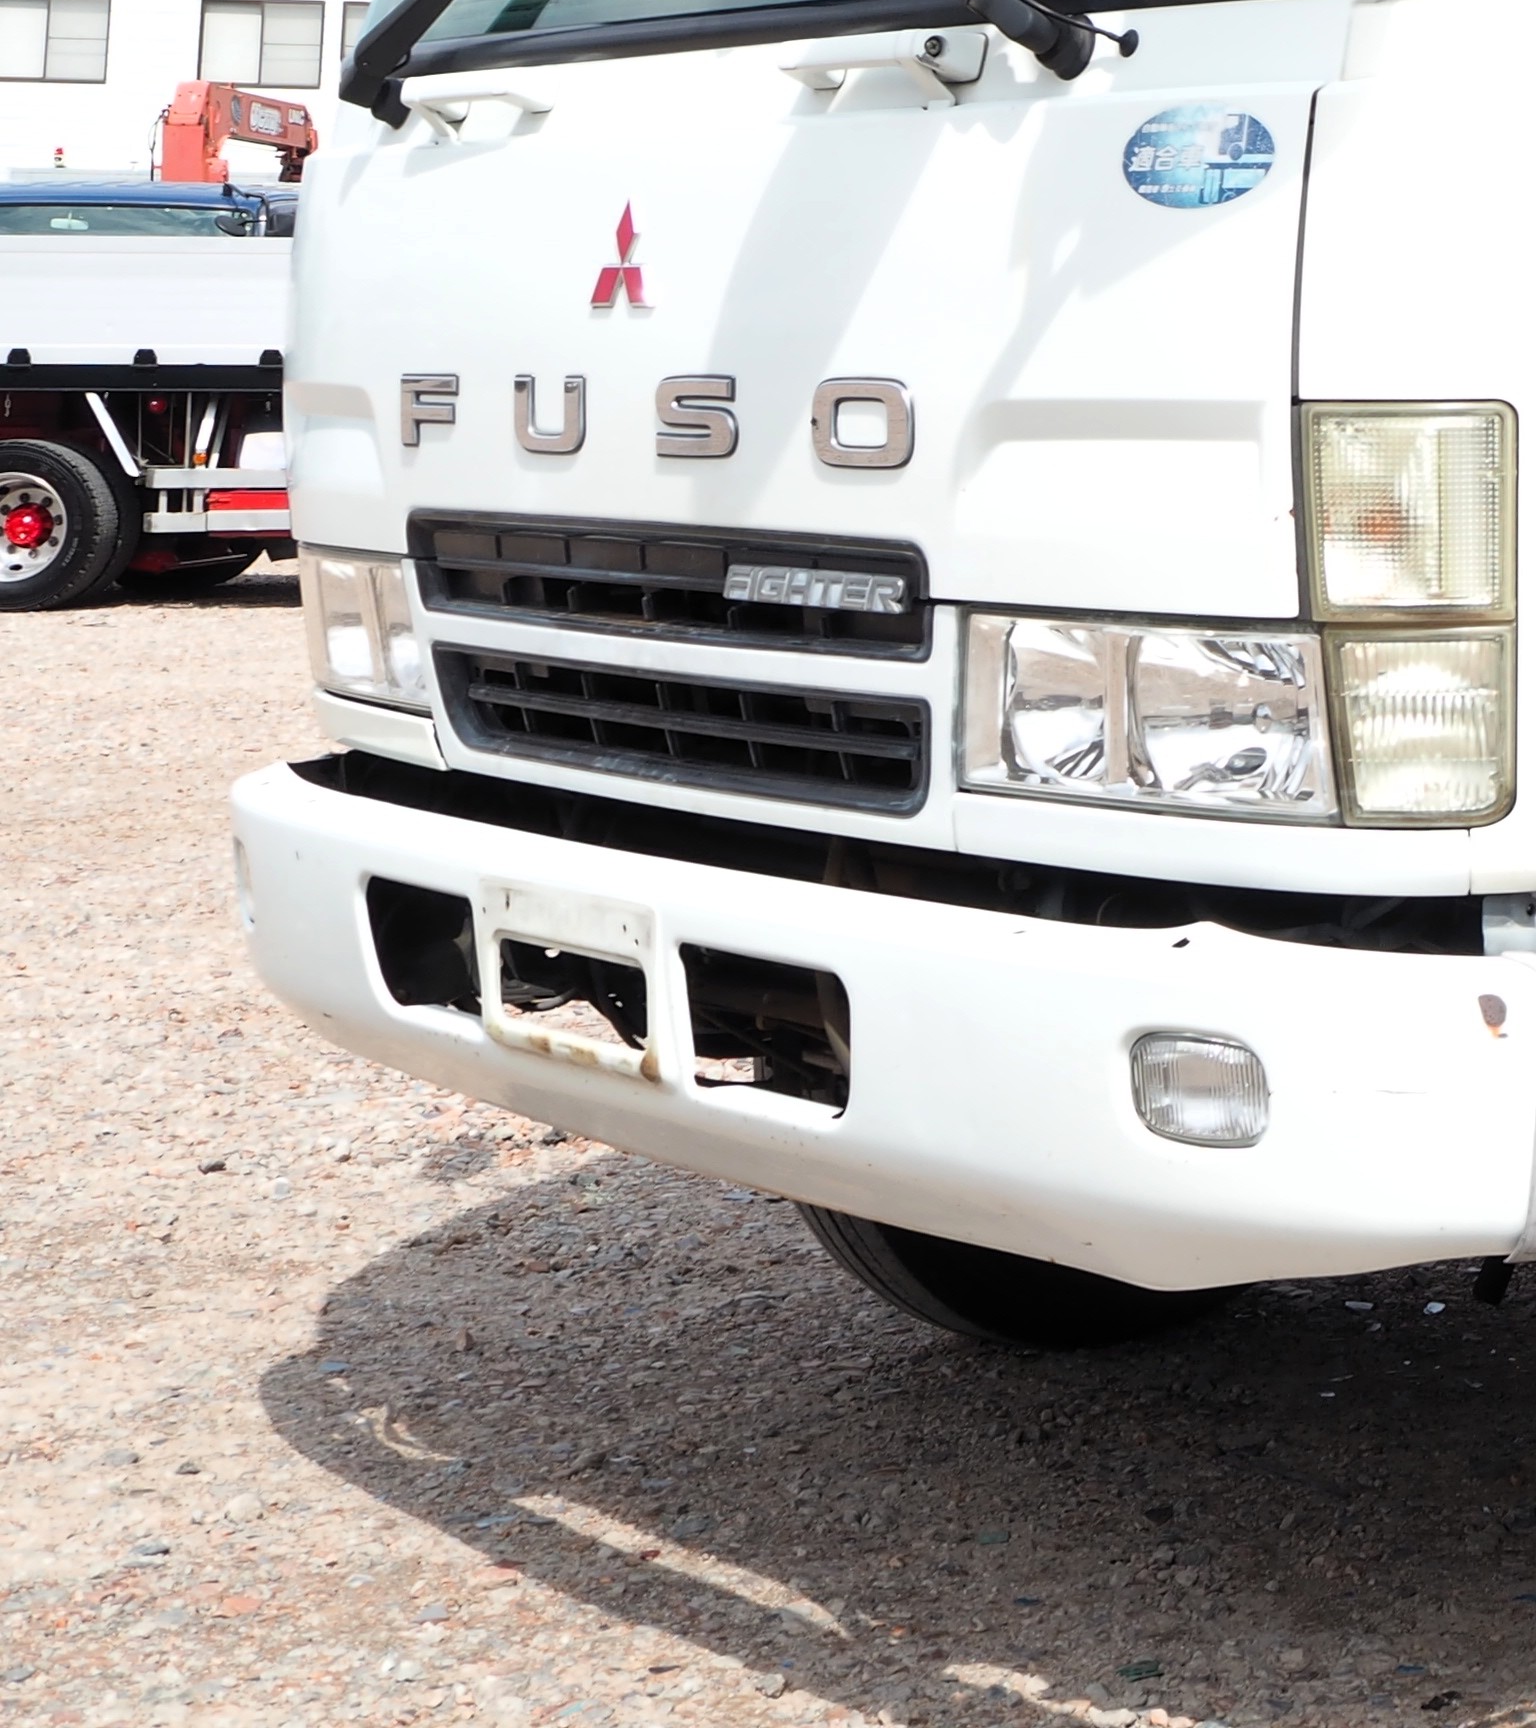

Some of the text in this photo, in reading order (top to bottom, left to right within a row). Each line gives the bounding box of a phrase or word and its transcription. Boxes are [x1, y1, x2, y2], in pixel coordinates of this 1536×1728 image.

[1128, 142, 1205, 171] 適合車
[401, 373, 916, 470] FUSO
[723, 564, 908, 614] FIGHTER
